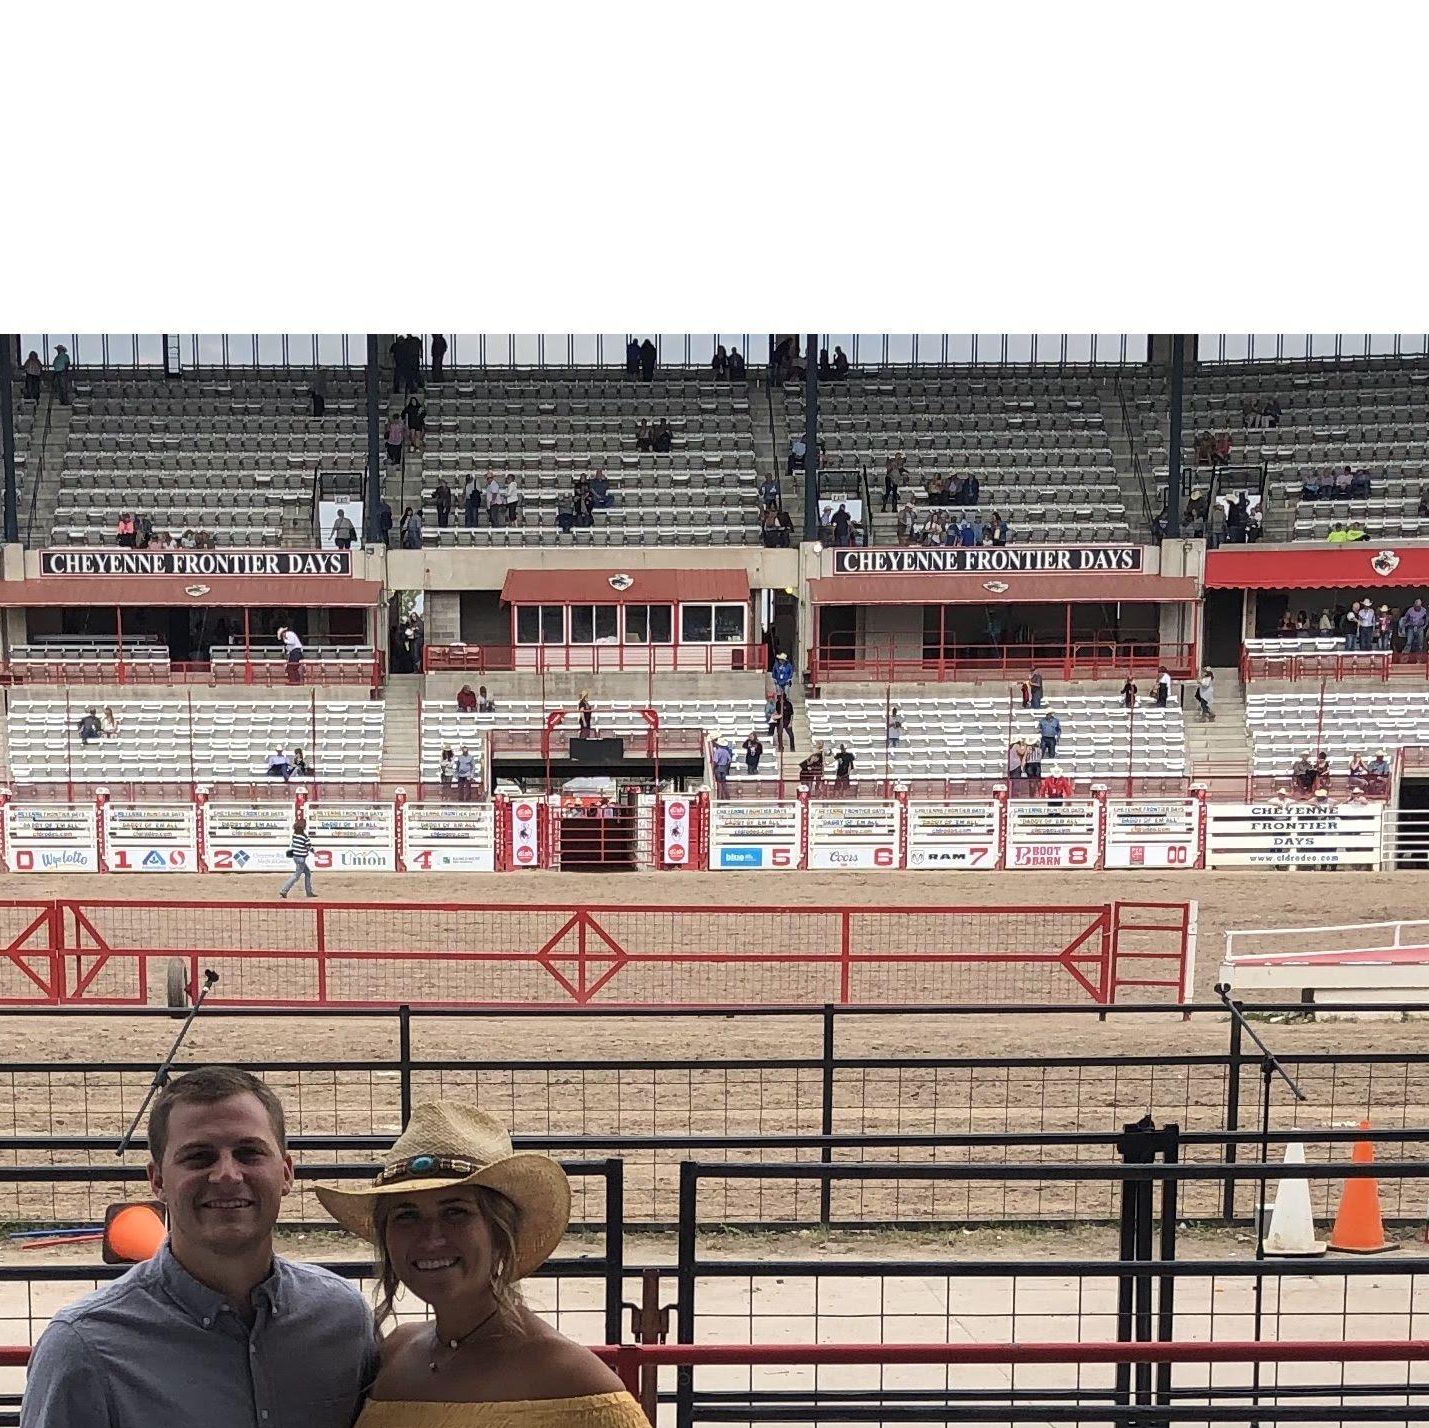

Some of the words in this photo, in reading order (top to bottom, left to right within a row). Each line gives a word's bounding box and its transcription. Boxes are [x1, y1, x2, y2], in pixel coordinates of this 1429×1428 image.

[50, 553, 166, 574] CHEYENNE
[172, 553, 281, 574] FRONTIER
[289, 553, 342, 574] DAYS
[843, 551, 958, 572] CHEYENNE
[965, 550, 1071, 571] FRONTIER
[1080, 549, 1133, 570] DAYS
[1251, 807, 1339, 815] CHEYENNE
[115, 851, 132, 868] 1
[214, 851, 232, 868] 2
[315, 850, 332, 867] 3
[342, 850, 386, 865] Union
[772, 849, 790, 866] 5
[830, 851, 858, 861] Coors
[875, 848, 893, 866] 6
[970, 848, 988, 865] 7
[1033, 847, 1061, 855] BOOT
[1069, 847, 1087, 864] 8
[1168, 846, 1187, 863] 00
[17, 851, 33, 869] 0
[413, 851, 431, 869] 4
[1033, 857, 1061, 865] BARN
